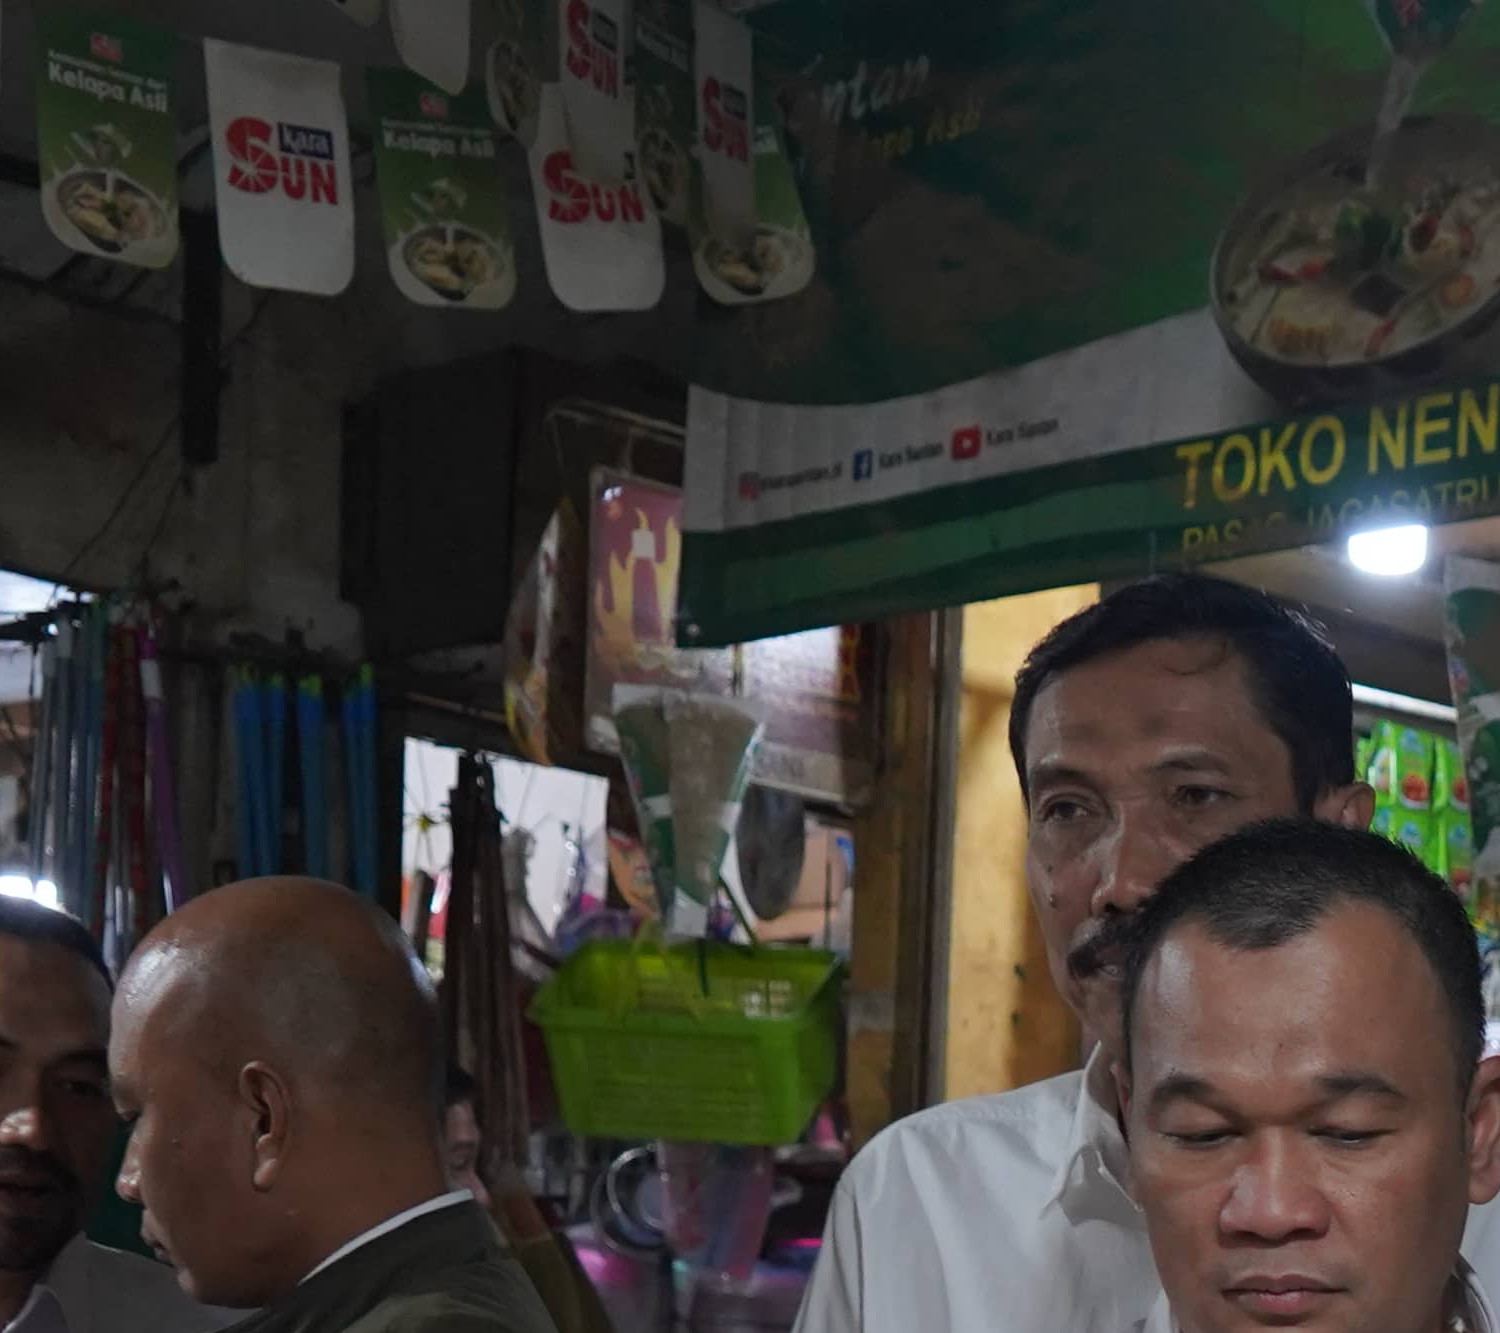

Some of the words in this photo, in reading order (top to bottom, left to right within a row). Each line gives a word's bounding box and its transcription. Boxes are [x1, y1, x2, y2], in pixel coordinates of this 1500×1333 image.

[48, 61, 124, 103] Kelapa
[130, 84, 168, 113] Asli
[226, 116, 338, 206] SUN
[282, 125, 331, 158] kara
[543, 151, 645, 223] SUN
[1175, 414, 1346, 510] TOKO
